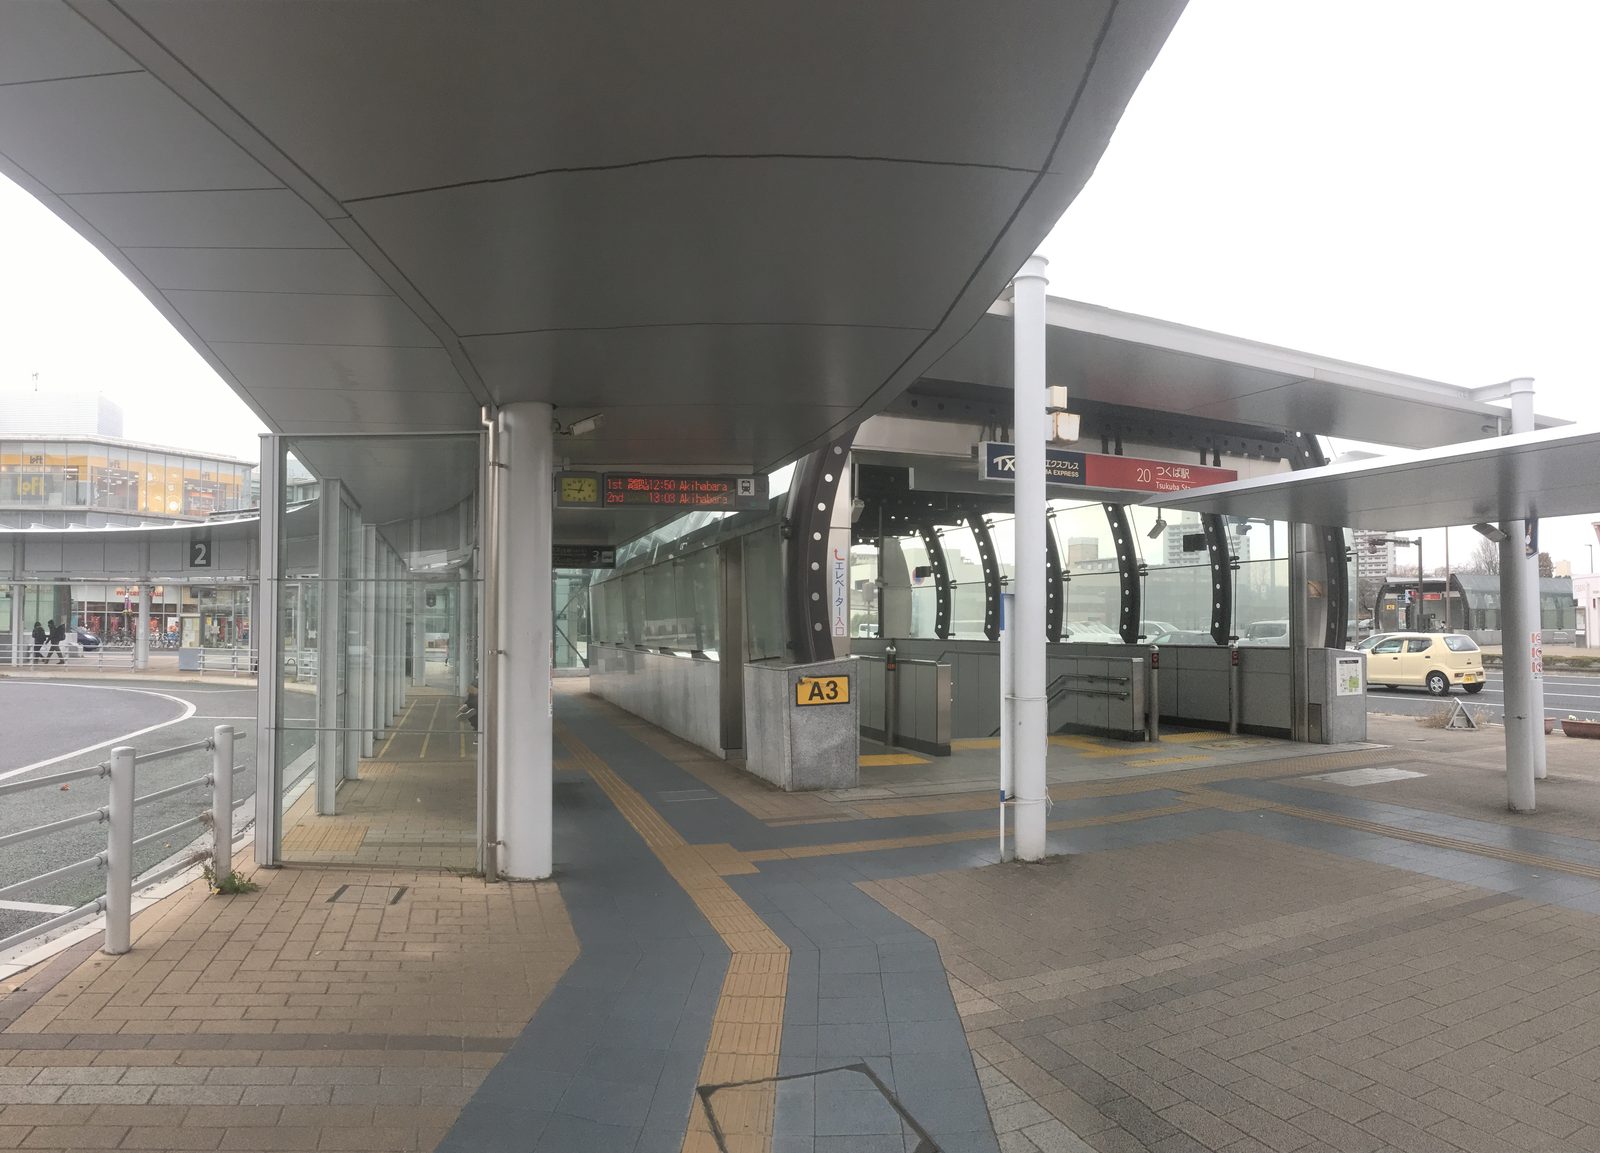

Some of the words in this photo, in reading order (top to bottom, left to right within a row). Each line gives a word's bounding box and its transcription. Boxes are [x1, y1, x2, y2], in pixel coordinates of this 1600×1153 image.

[1045, 459, 1079, 470] エクスプレス
[1053, 469, 1079, 478] EXPRESS
[1136, 467, 1152, 483] 20
[1155, 466, 1190, 479] つくば駅
[607, 479, 623, 490] 1st
[649, 479, 676, 491] 12:50
[679, 480, 728, 491] Akihabara
[1155, 481, 1180, 491] Tsukuba
[607, 491, 624, 503] 2nd
[679, 493, 728, 504] Akihabara
[194, 543, 207, 565] 2
[591, 550, 600, 563] 3
[835, 561, 845, 636] エレベーター入口
[808, 680, 839, 701] A3
